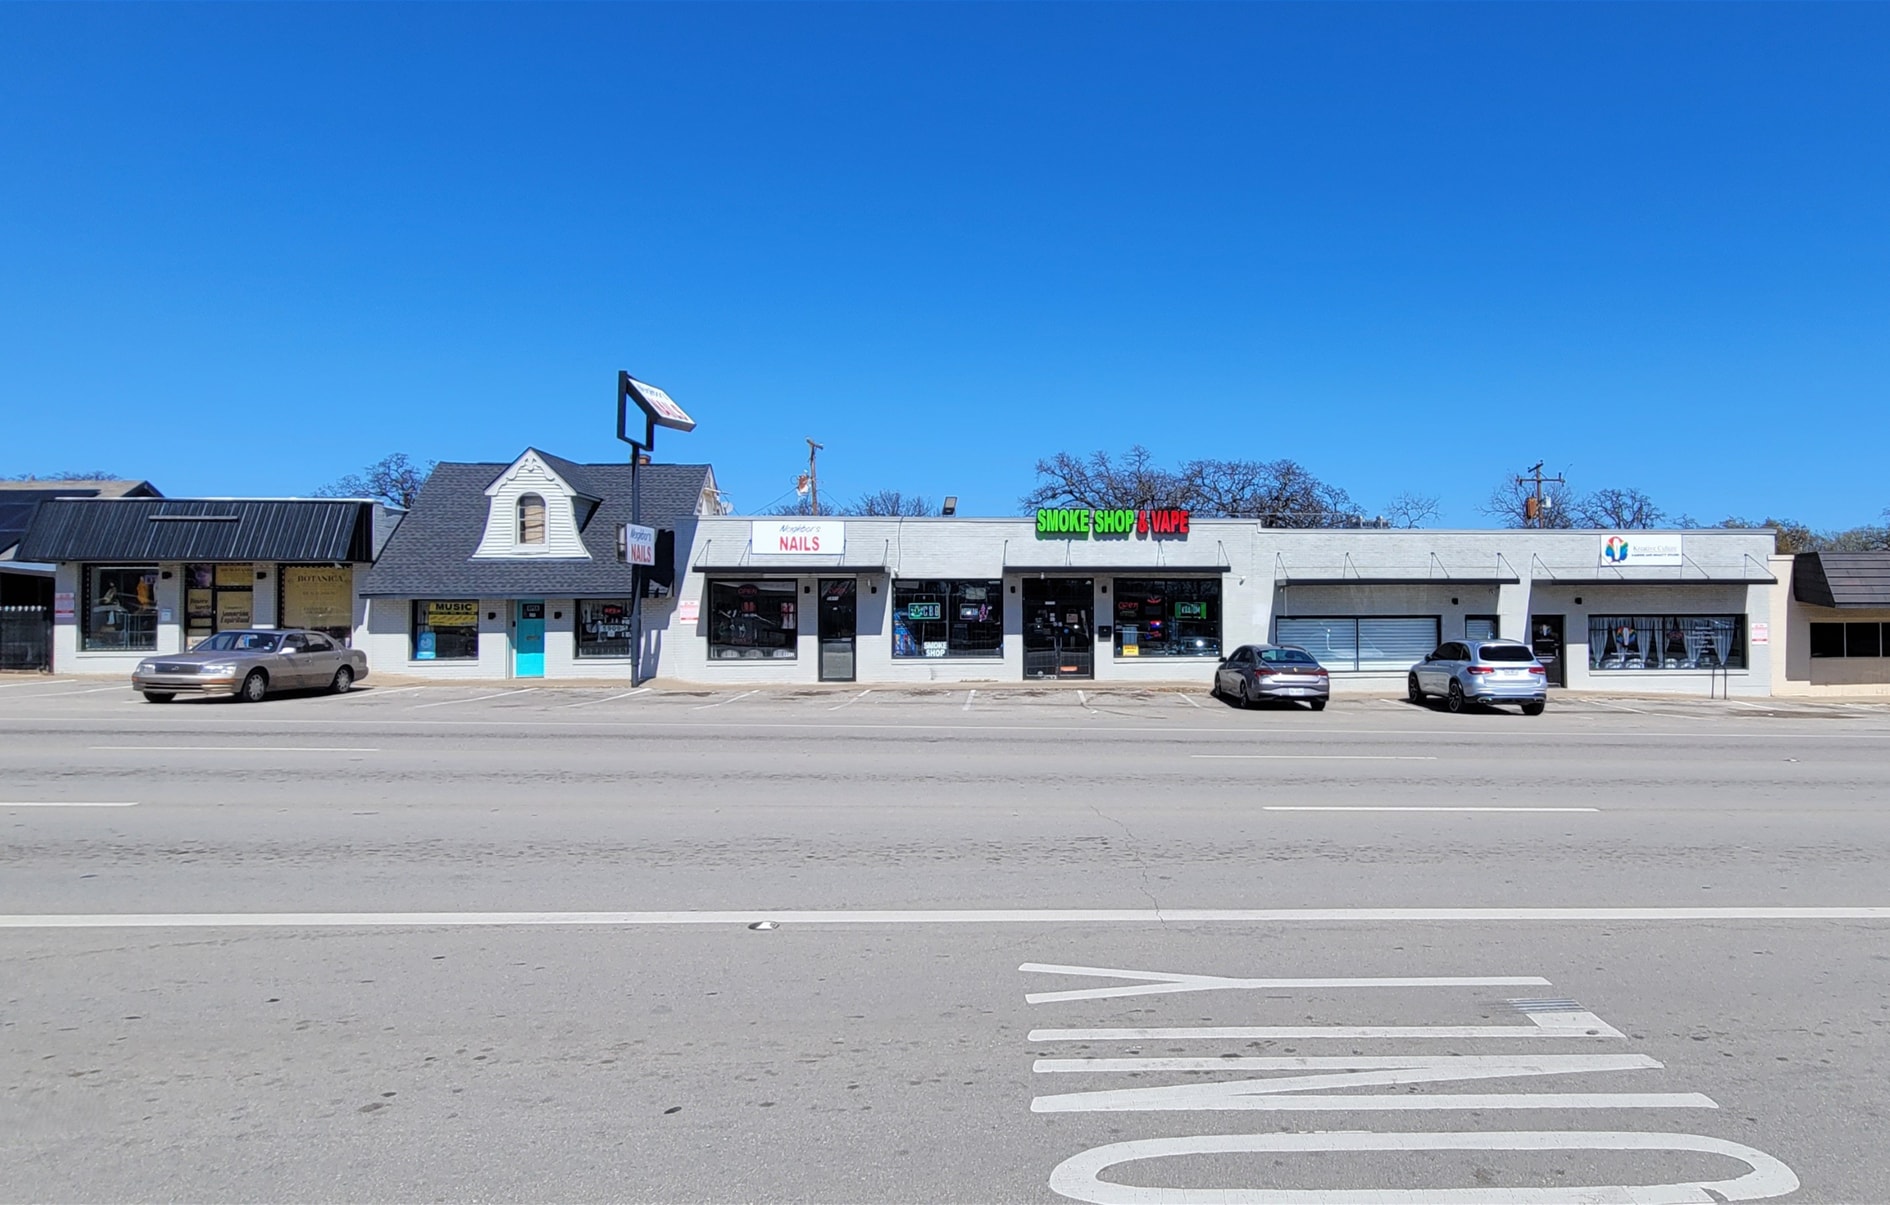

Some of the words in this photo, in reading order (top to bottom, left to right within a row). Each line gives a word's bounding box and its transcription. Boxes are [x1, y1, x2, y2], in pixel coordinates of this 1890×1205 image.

[1036, 508, 1090, 533] SMOKE
[1094, 509, 1135, 533] SHOP
[1137, 509, 1150, 533] &
[1151, 509, 1190, 534] VAPE
[779, 536, 820, 551] NAILS
[631, 543, 652, 563] NAILS
[435, 603, 473, 611] MUSIC
[922, 605, 940, 617] CBD
[923, 641, 948, 650] SMOKE
[925, 649, 946, 657] SHOP
[1018, 962, 1801, 1205] ONLY
